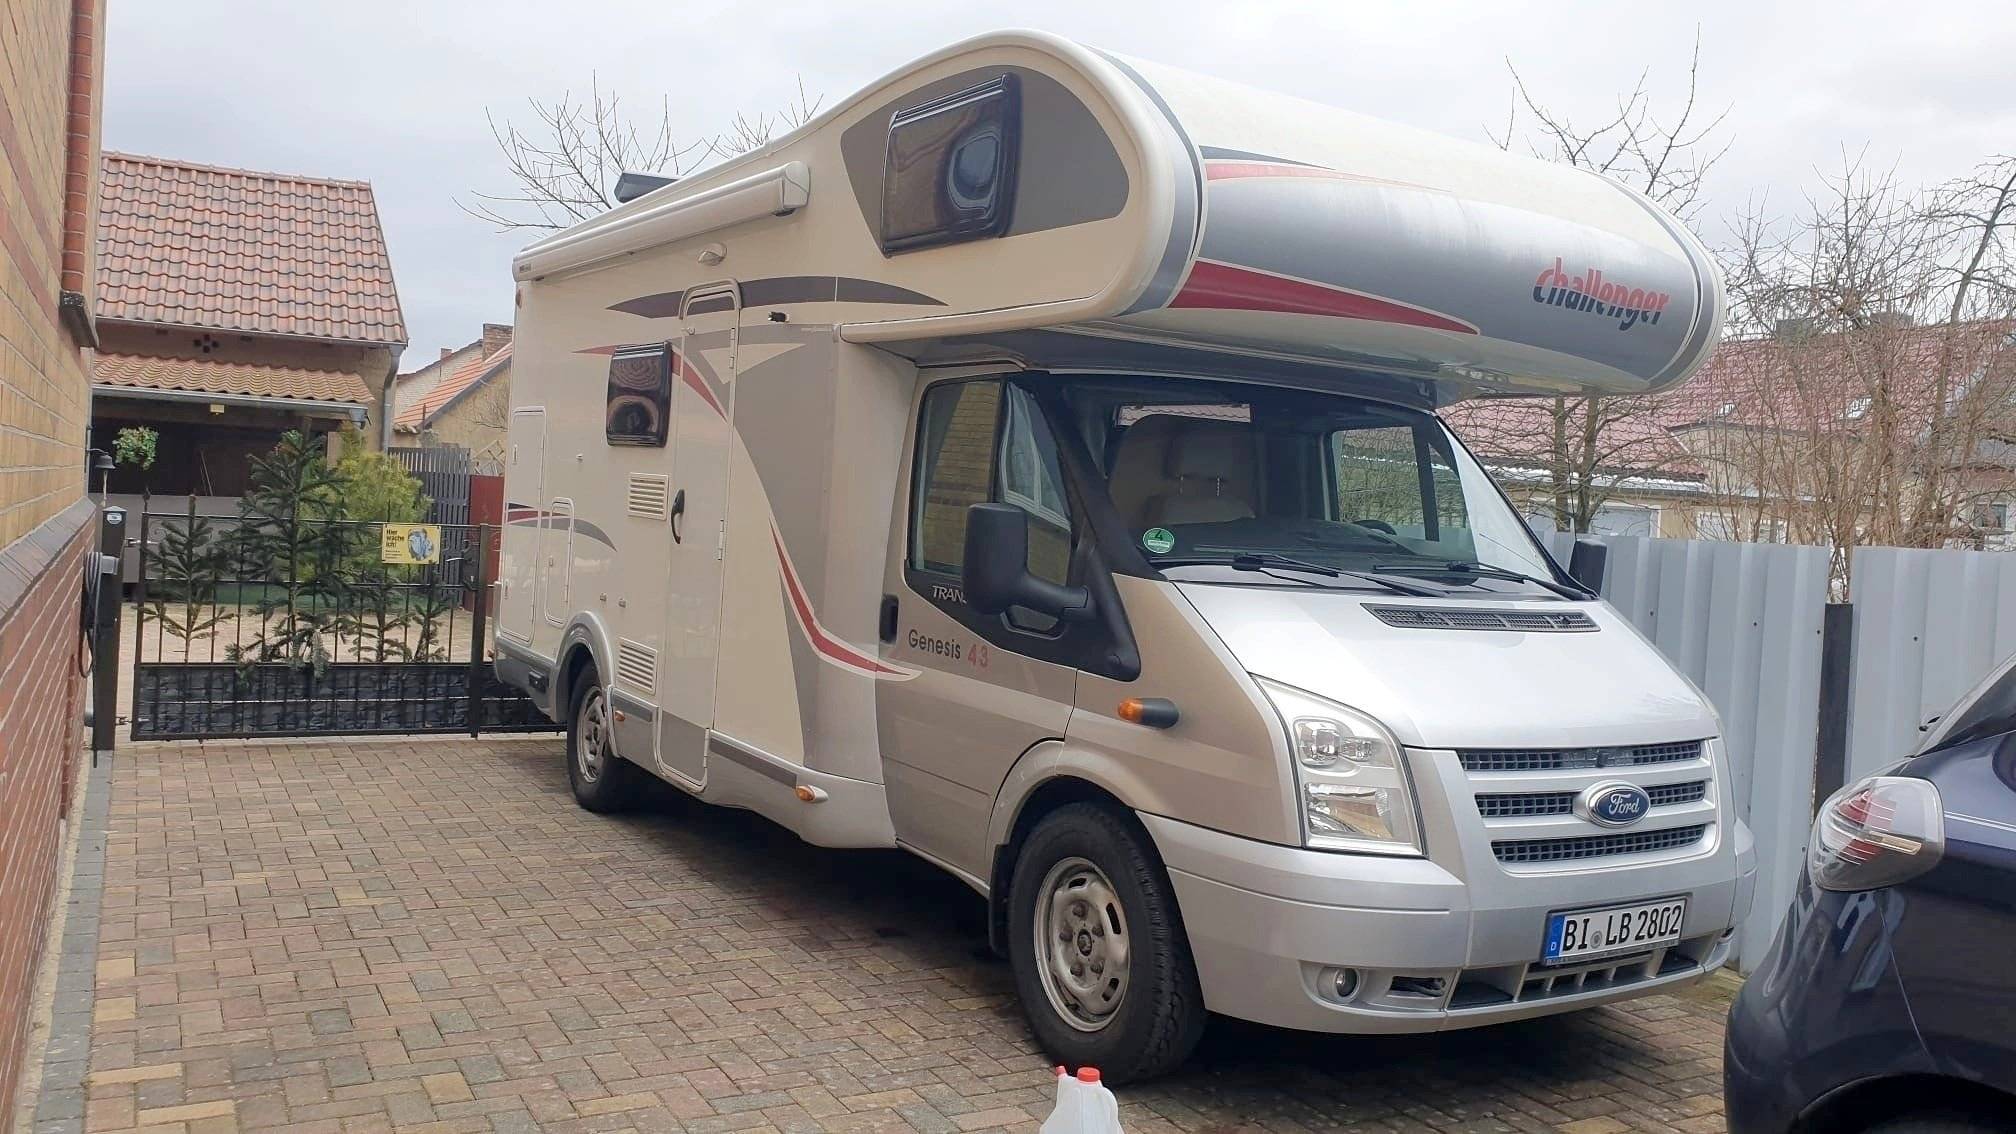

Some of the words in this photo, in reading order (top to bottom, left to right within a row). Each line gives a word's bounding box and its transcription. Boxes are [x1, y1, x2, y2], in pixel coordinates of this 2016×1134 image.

[1533, 256, 1671, 331] challenger
[1155, 530, 1163, 540] 4
[932, 585, 967, 604] TRAN
[908, 629, 961, 660] Genesis
[967, 644, 989, 668] 43
[1608, 793, 1640, 816] Ford
[1562, 918, 1590, 952] BI
[1605, 912, 1632, 946] LB
[1635, 904, 1682, 941] 2802
